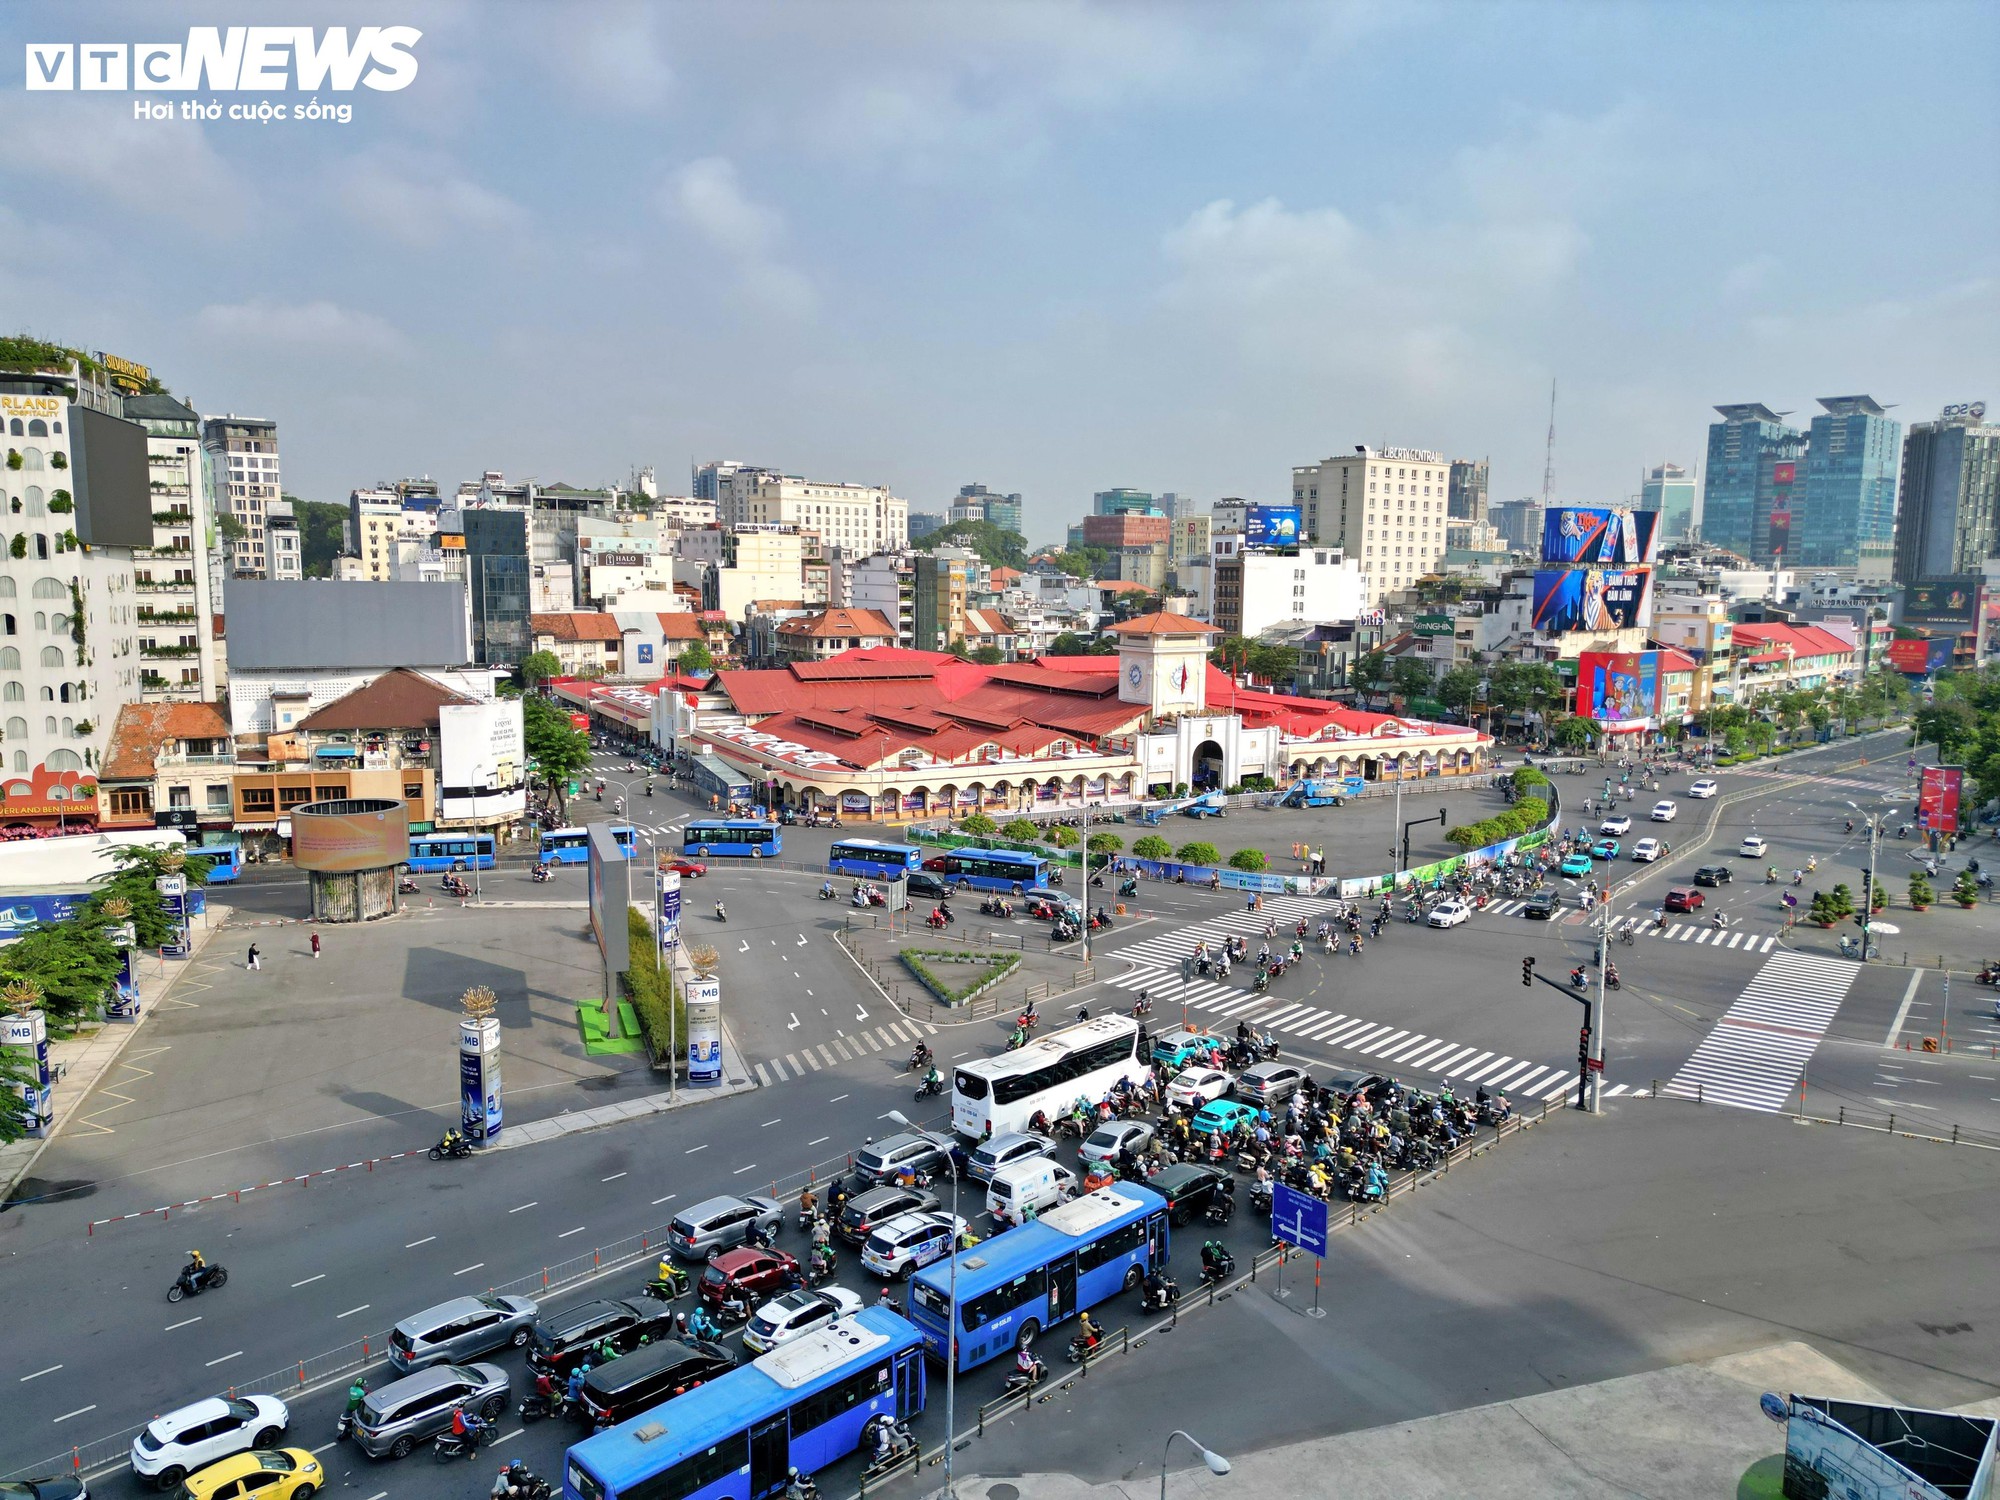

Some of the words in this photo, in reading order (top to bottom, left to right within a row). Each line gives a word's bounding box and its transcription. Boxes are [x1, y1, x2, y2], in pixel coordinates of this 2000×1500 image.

[105, 354, 150, 380] SILVERLAND
[7, 409, 59, 418] HOSPITALITY
[1577, 512, 1601, 532] Tiger
[1834, 599, 1868, 607] LUXURY
[62, 804, 94, 812] THANH
[702, 988, 718, 997] MB
[11, 1027, 31, 1037] MB
[464, 1036, 479, 1046] MB
